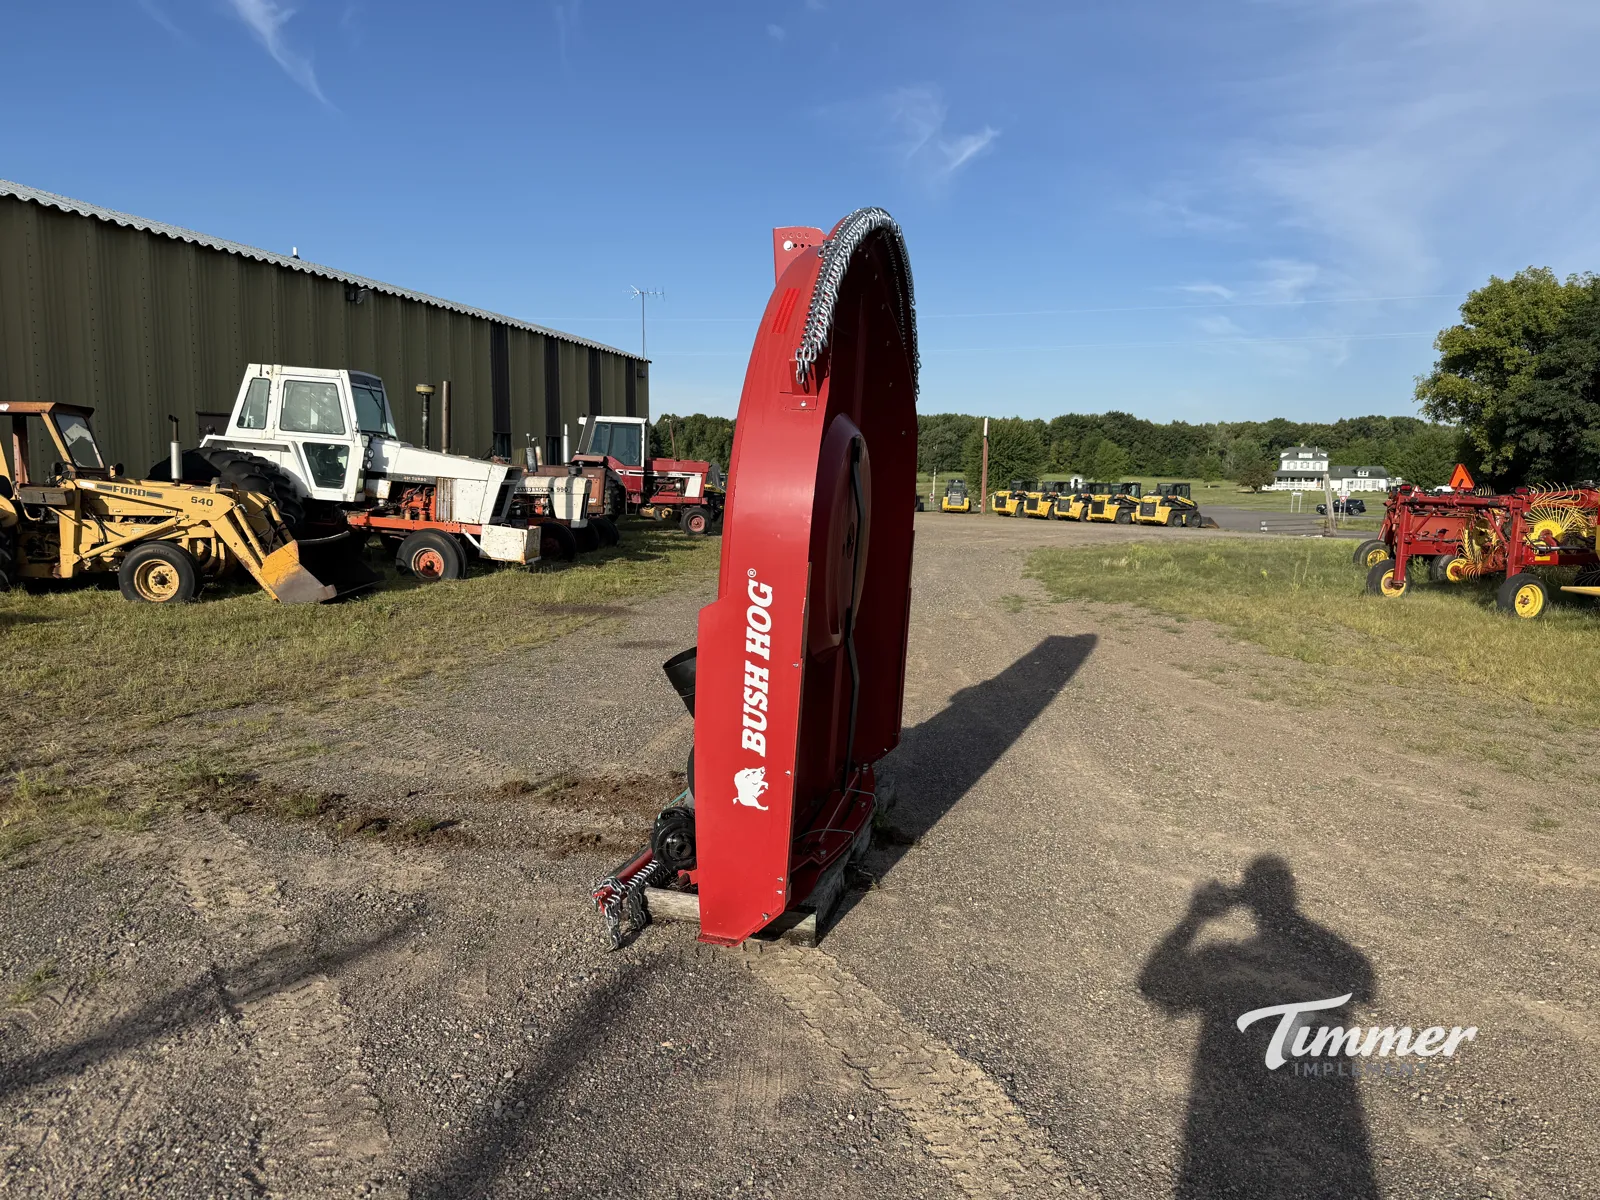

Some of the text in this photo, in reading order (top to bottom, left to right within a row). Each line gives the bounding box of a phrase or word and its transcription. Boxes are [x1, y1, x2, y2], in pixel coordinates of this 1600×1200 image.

[112, 485, 147, 497] FORD
[190, 496, 214, 507] 540
[741, 659, 770, 758] BUSH
